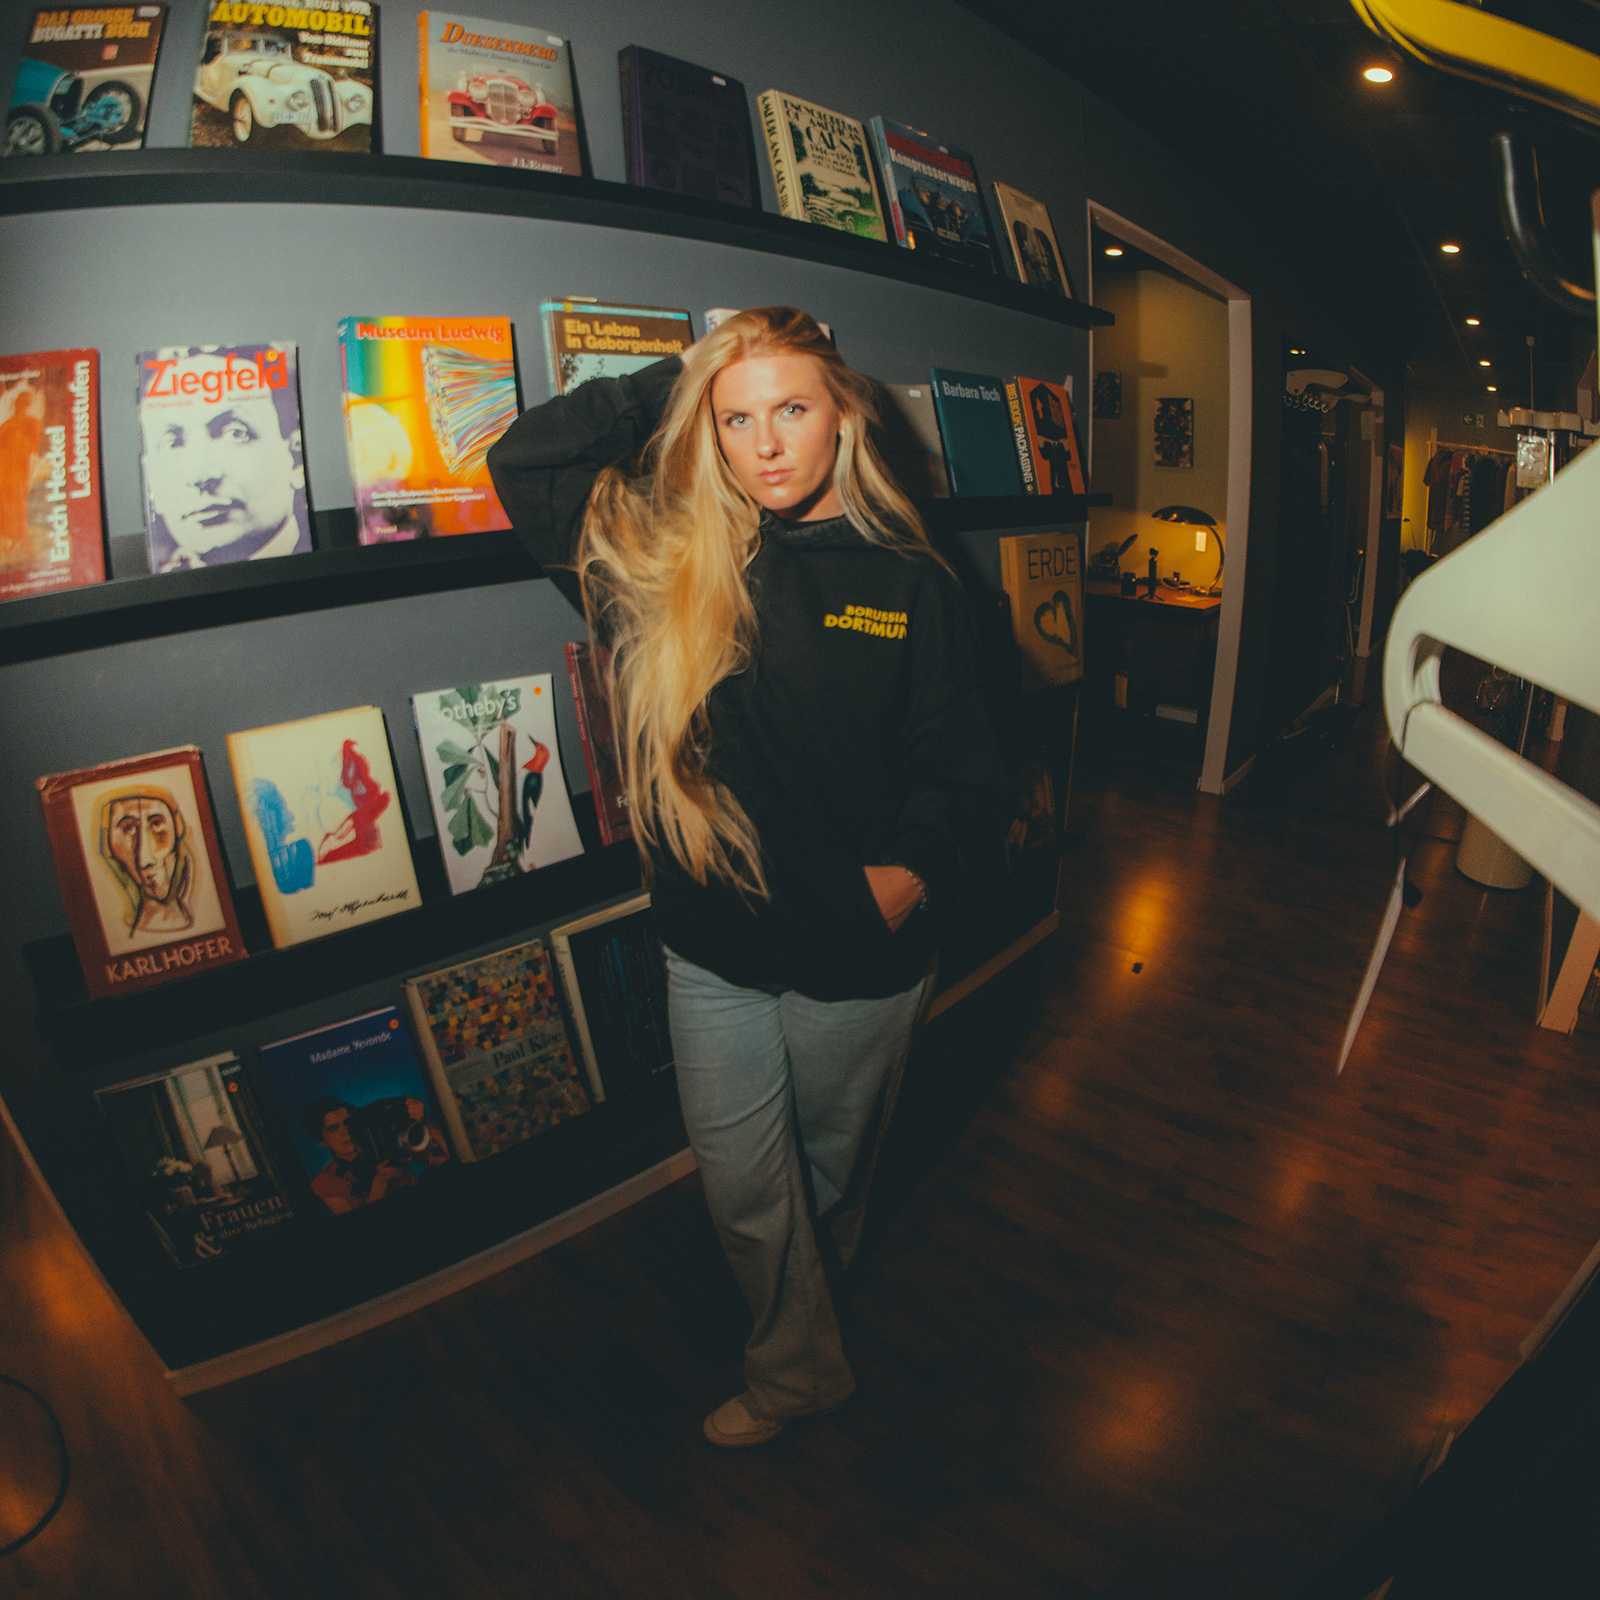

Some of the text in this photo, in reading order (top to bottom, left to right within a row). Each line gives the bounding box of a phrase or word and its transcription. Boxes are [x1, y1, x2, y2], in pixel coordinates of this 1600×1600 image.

[208, 1, 370, 36] AUTOMOBIL
[356, 322, 435, 341] Museum
[438, 322, 503, 344] Ludwig
[564, 318, 641, 338] Ein Leben
[584, 335, 684, 354] Geborgenheit
[143, 350, 288, 404] Ziegfeld
[941, 380, 980, 399] Barbara
[70, 359, 91, 499] Lebensstufen
[46, 425, 67, 503] Heckel
[1014, 425, 1034, 483] PACKAGING
[47, 503, 70, 563] Erich
[1027, 545, 1077, 580] ERDE
[845, 604, 908, 624] BORUSSIA
[434, 689, 518, 721] otheby's
[105, 936, 233, 984] KARL HOFER
[199, 1195, 284, 1231] Frauen
[193, 1231, 224, 1259] &
